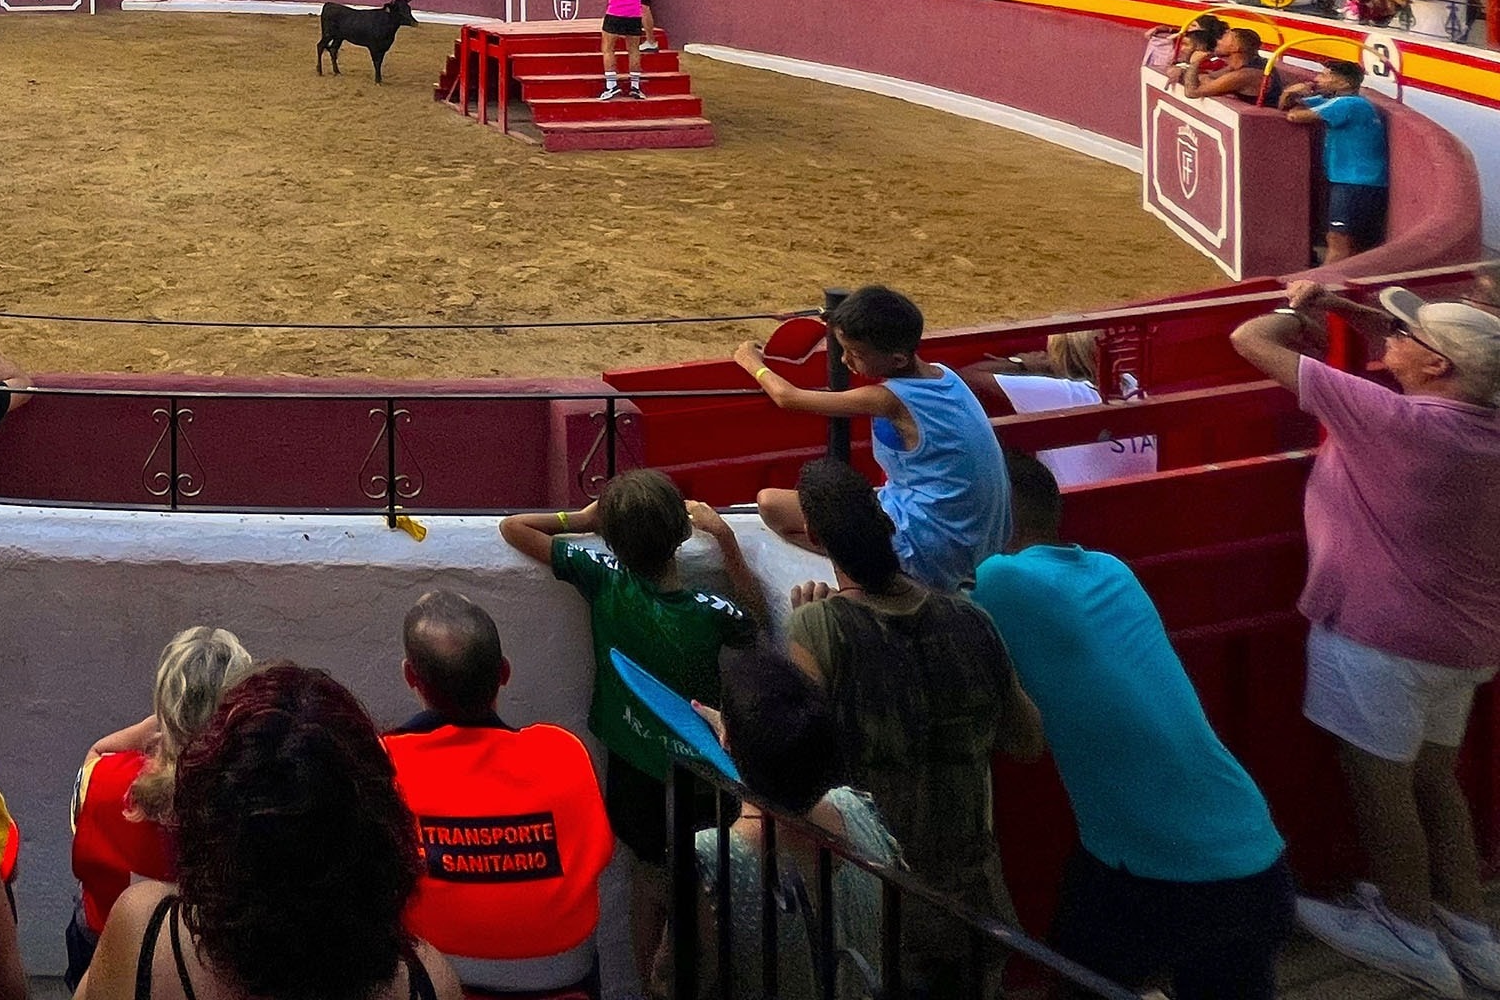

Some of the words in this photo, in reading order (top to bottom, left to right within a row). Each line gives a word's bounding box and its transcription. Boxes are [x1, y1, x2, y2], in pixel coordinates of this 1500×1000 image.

[1372, 43, 1390, 78] 3
[423, 822, 554, 846] TRANSPORTE
[442, 851, 547, 873] SANITARIO
